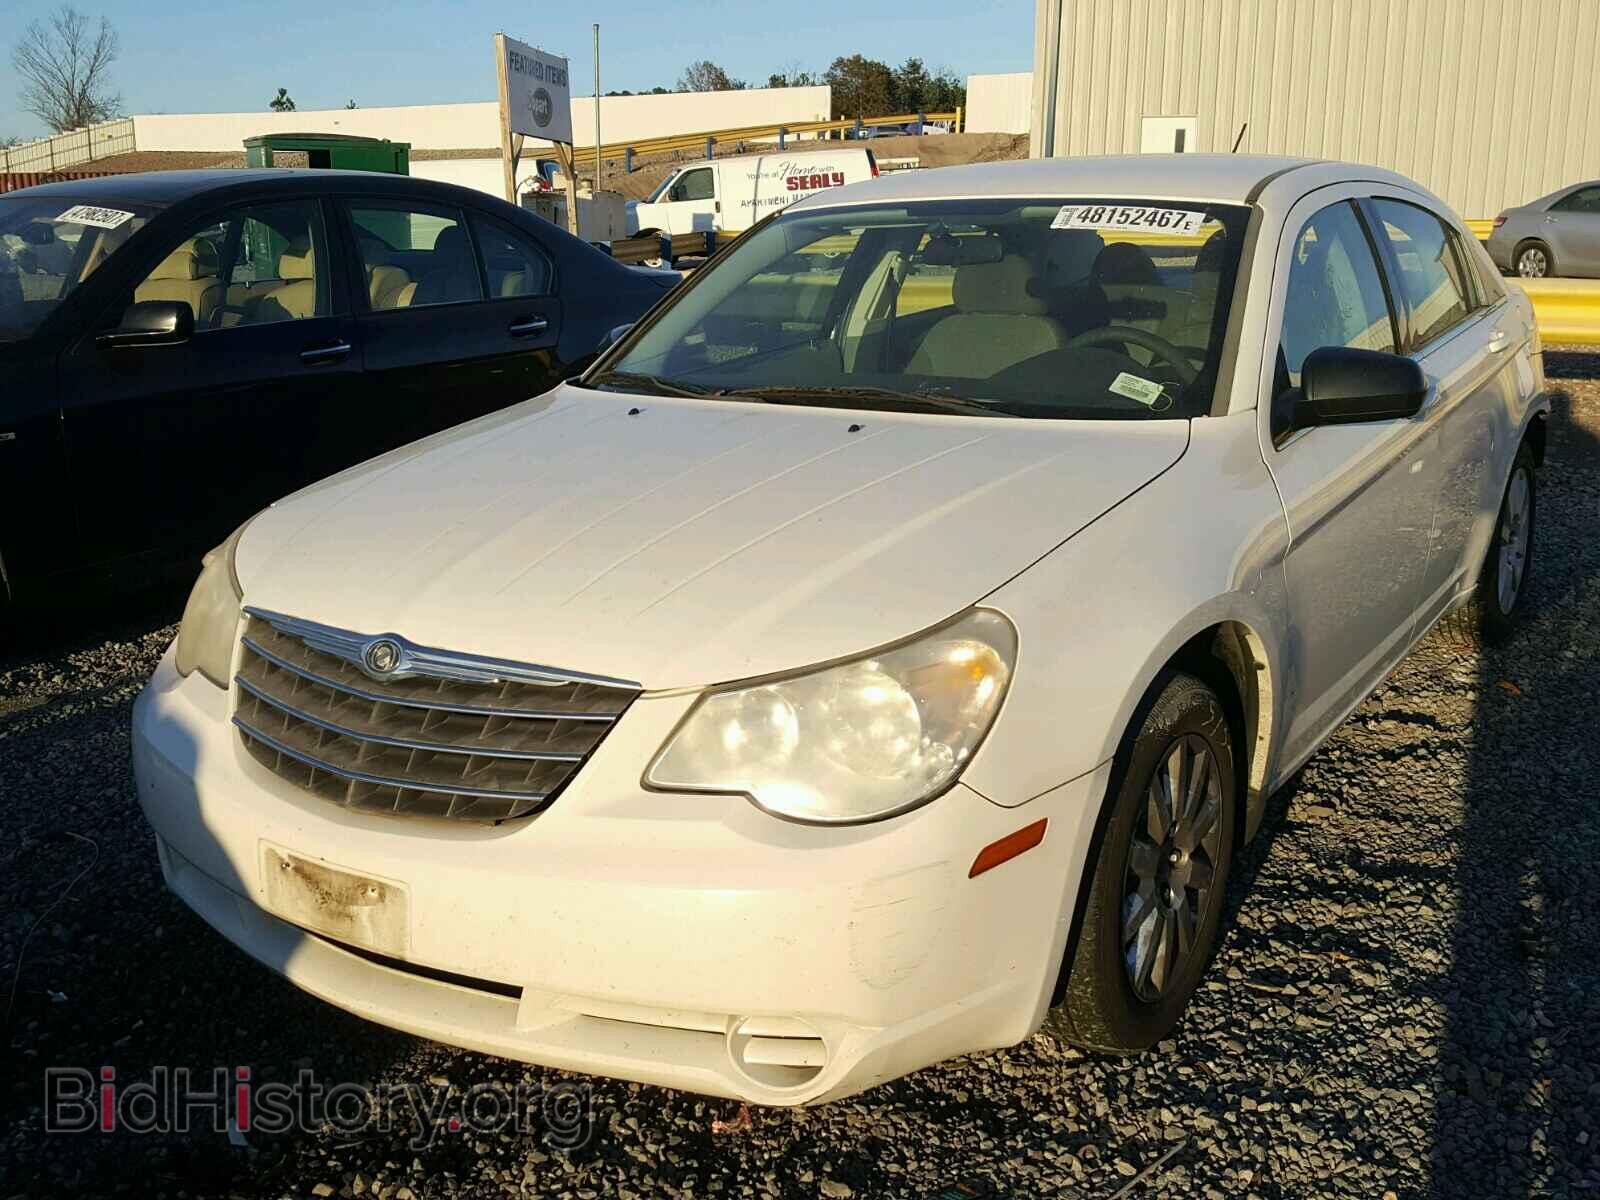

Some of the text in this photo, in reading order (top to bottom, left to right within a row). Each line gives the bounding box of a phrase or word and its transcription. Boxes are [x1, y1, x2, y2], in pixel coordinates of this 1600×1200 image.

[509, 50, 568, 87] FEATURED ITEMS
[779, 160, 816, 180] Home
[786, 172, 844, 191] SEALY
[1077, 206, 1193, 231] 48152467 E
